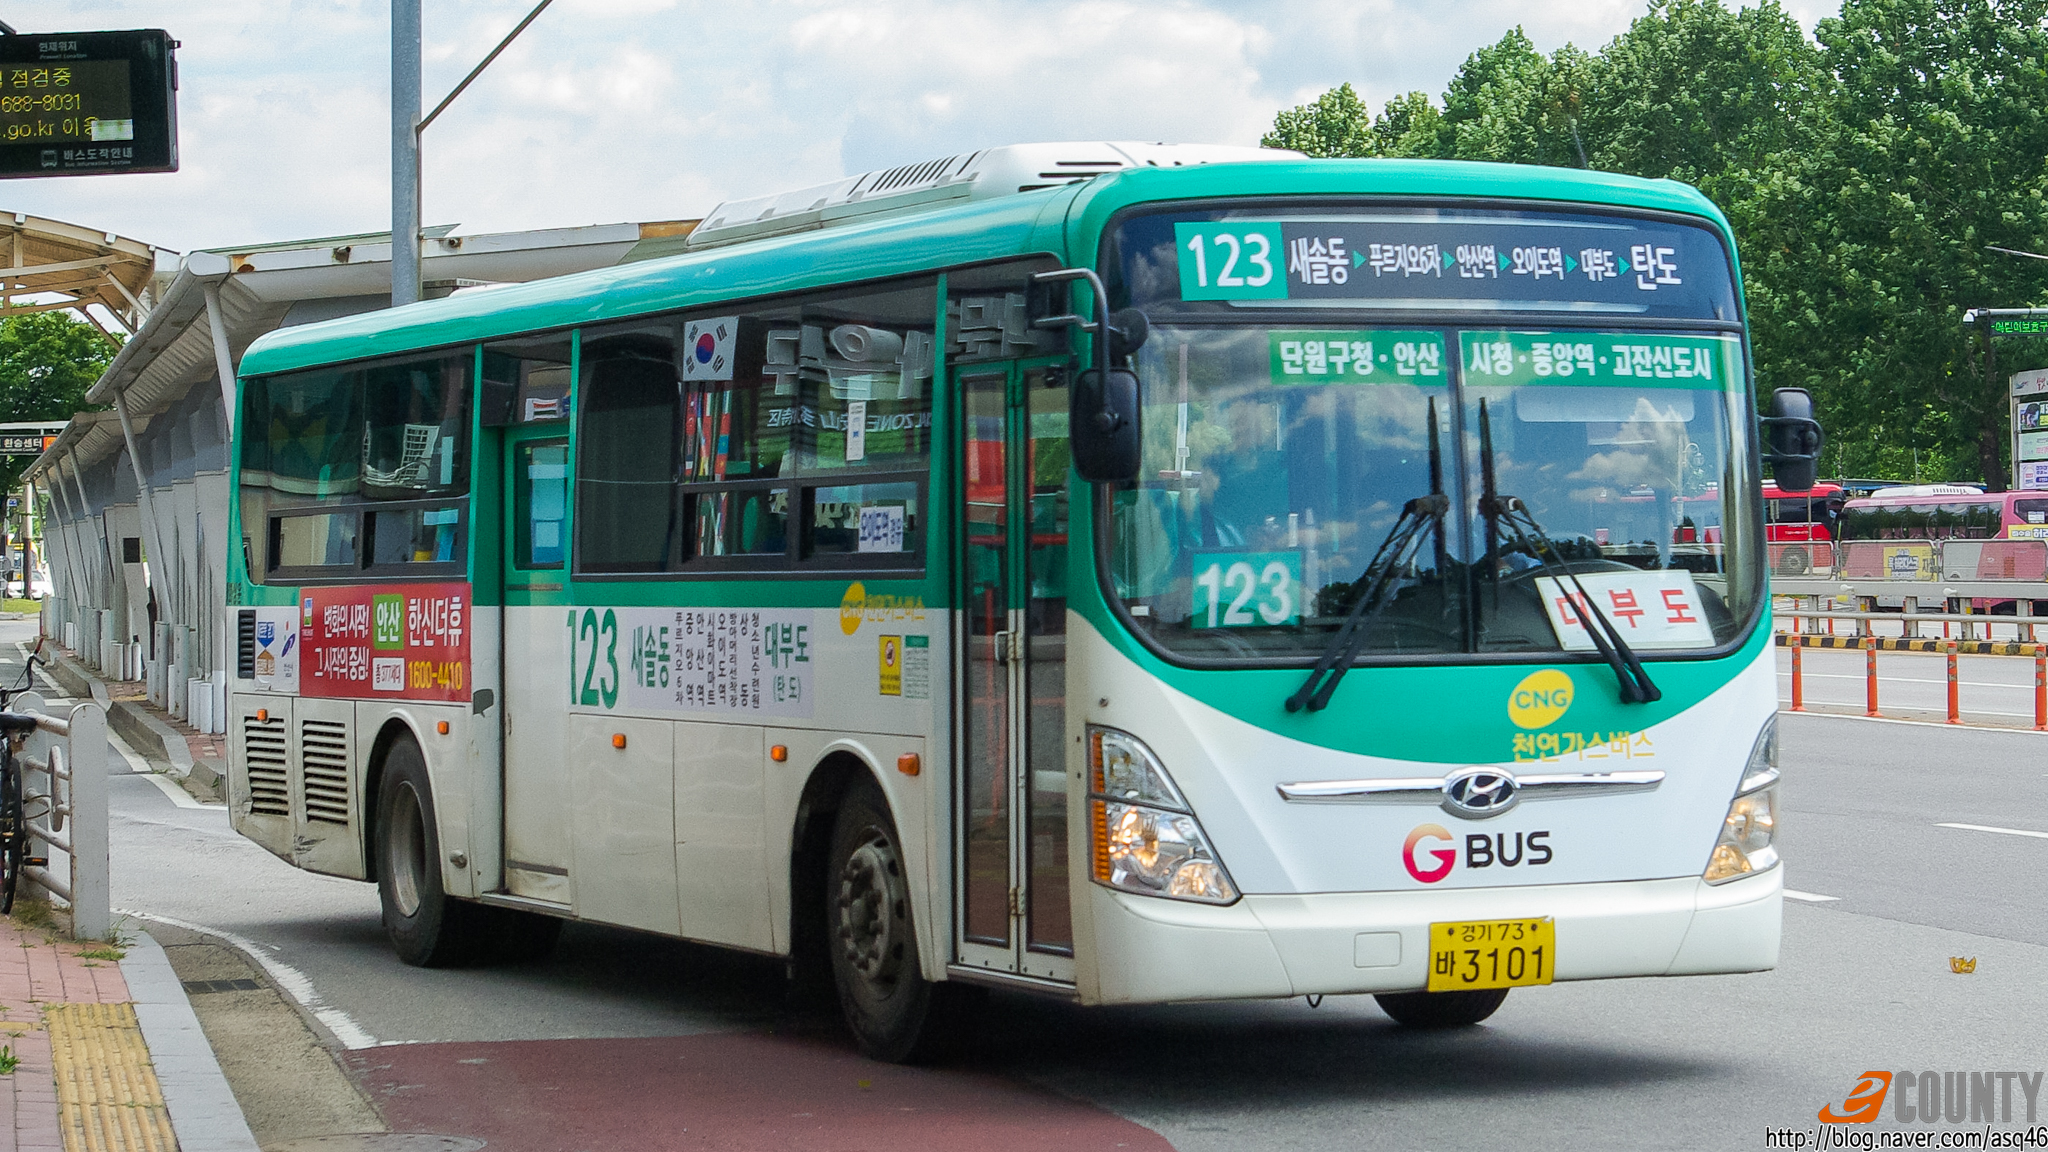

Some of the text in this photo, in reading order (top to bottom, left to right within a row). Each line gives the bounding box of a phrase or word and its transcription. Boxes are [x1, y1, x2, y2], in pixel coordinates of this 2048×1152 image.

[11, 67, 72, 89] 점검중
[1187, 232, 1682, 291] 123 새솔동 푸르지오6차 안산역 오이도역 대부도 탄도
[4, 438, 42, 448] 환승센터
[1198, 561, 1291, 628] 123
[1555, 588, 1697, 630] 대부도
[323, 604, 349, 639] 변화의
[376, 601, 400, 643] 안산
[408, 596, 462, 647] 한신더휴
[567, 608, 619, 709] 123
[631, 625, 671, 688] 새솔동
[717, 613, 727, 704] 오이도역
[764, 622, 809, 668] 대부도
[408, 661, 463, 690] 1600-4410
[1514, 689, 1567, 709] CNG
[1512, 730, 1655, 763] 천연가스버스
[1402, 823, 1553, 884] G BUS
[1436, 945, 1543, 983] 바 3101
